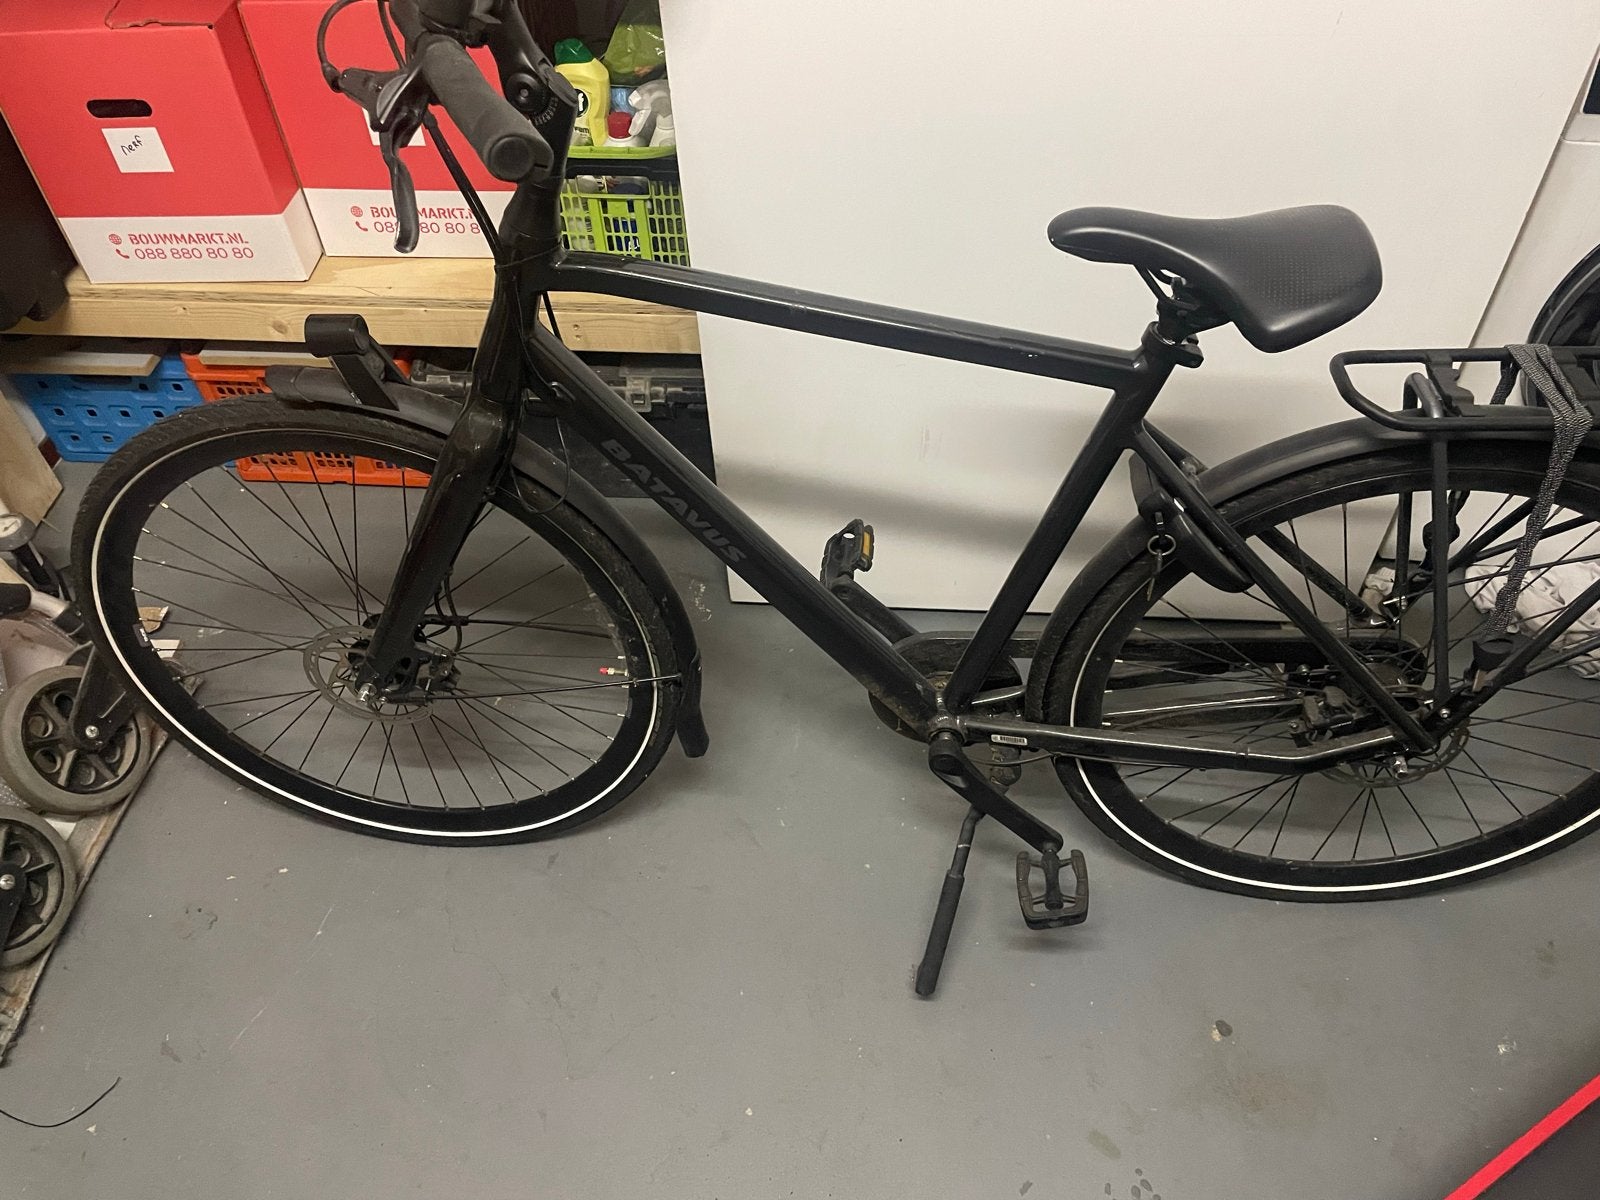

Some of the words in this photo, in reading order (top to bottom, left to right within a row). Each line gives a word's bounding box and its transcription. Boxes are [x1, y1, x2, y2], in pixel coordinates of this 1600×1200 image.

[419, 221, 441, 234] 80
[444, 222, 466, 235] 80
[128, 233, 249, 245] BOUWMARKT.NL
[134, 247, 168, 260] 088
[170, 247, 203, 260] 880
[205, 247, 229, 259] 80
[232, 246, 255, 259] 80
[600, 438, 748, 564] BATAVUS
